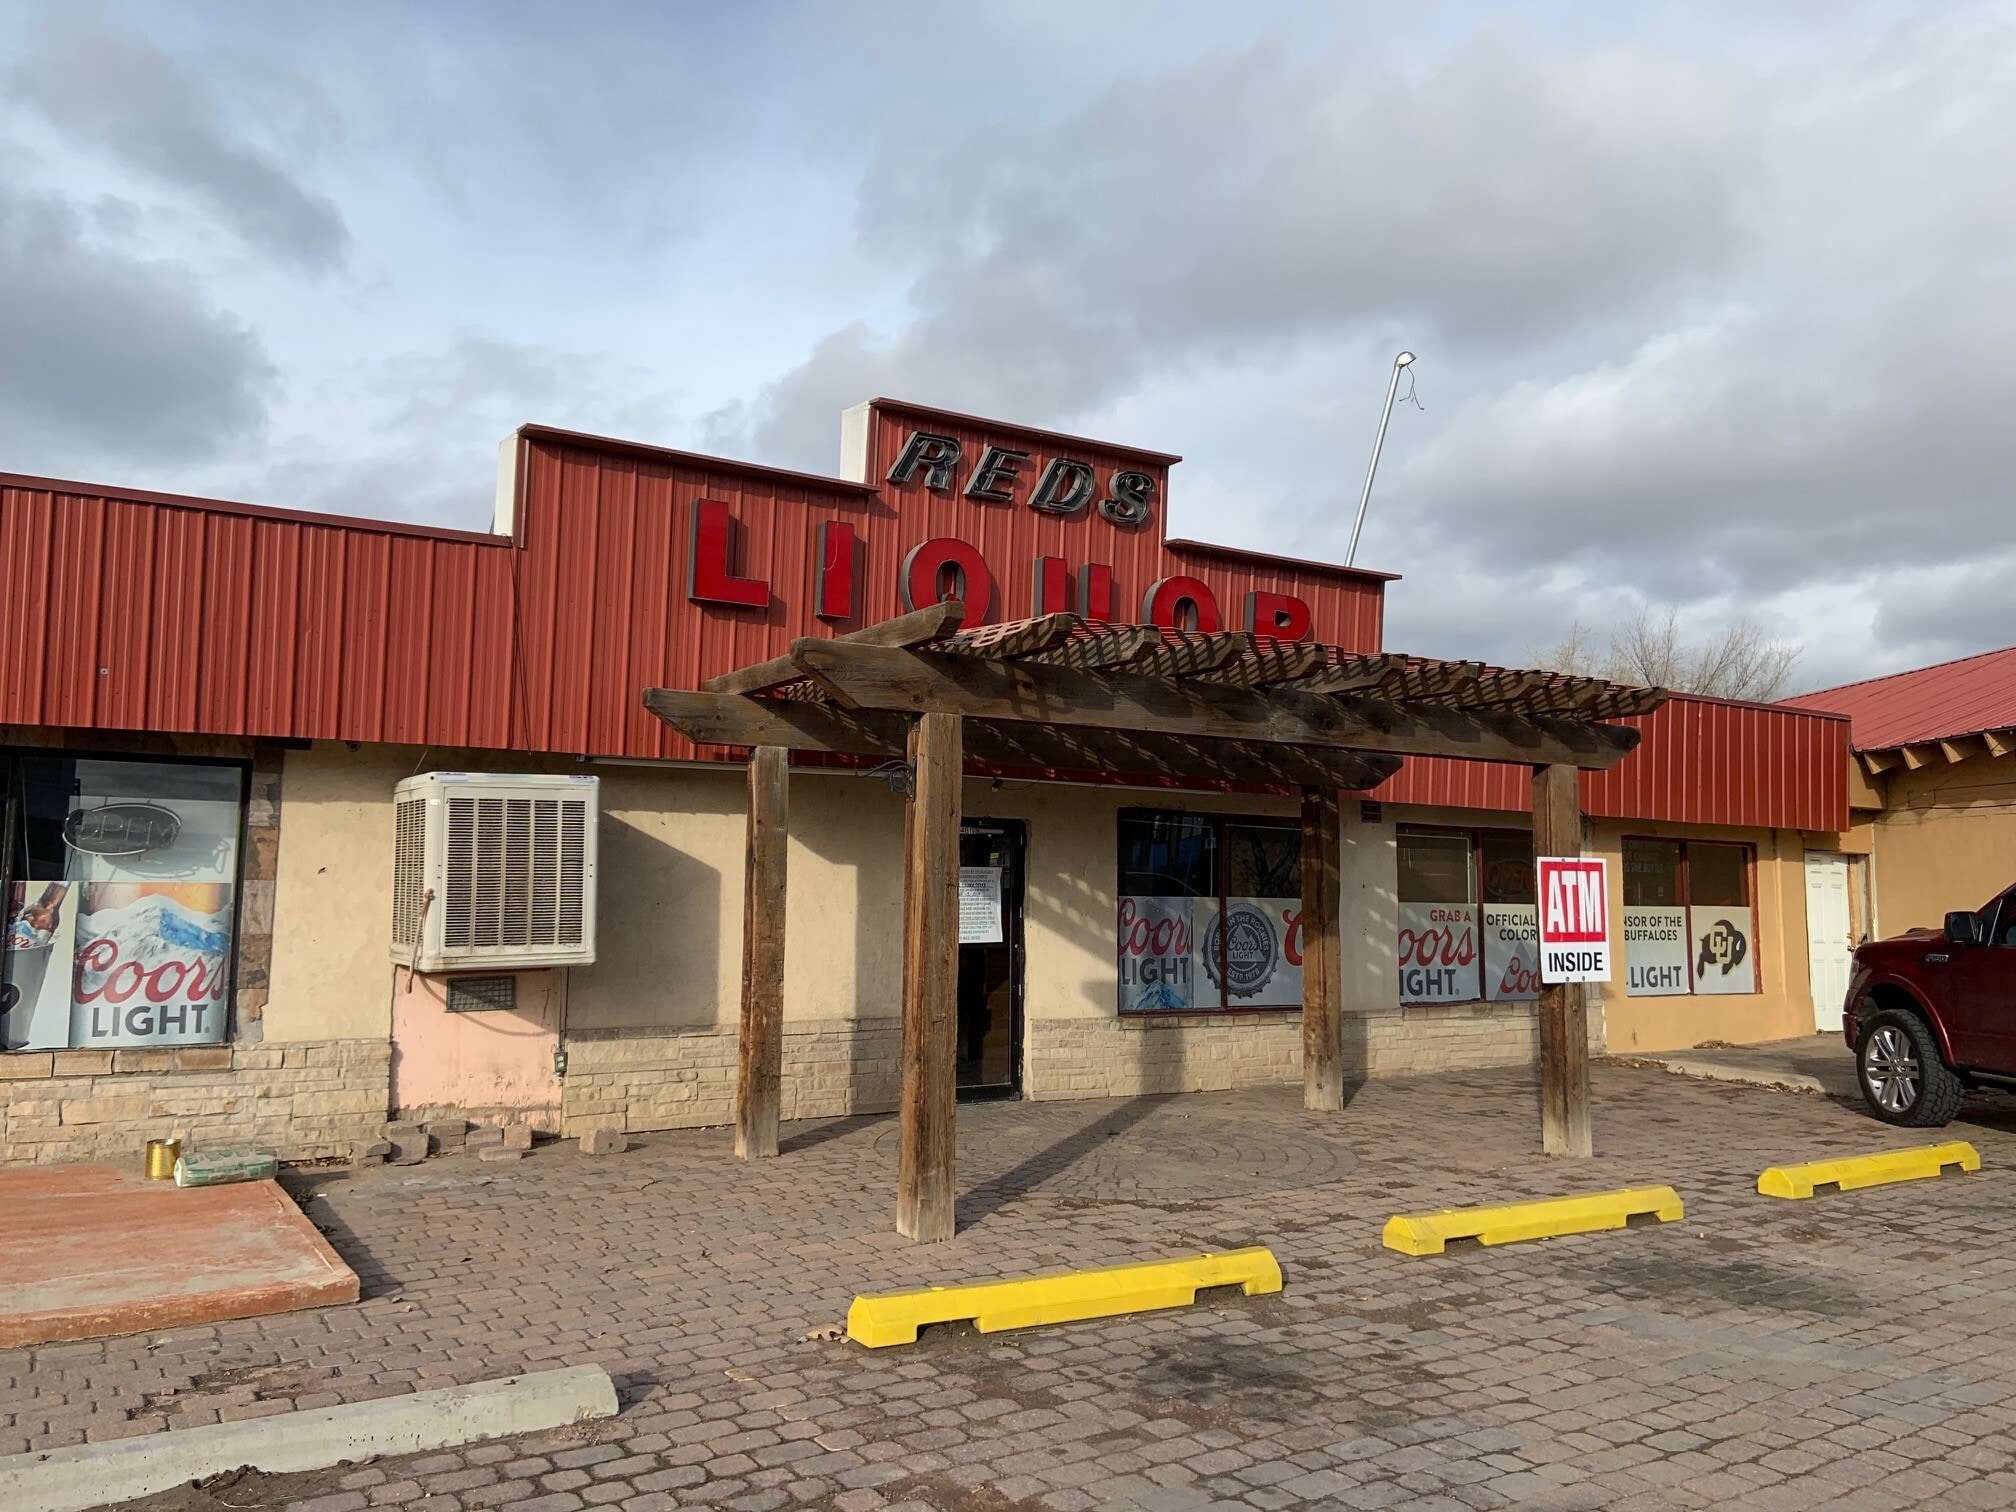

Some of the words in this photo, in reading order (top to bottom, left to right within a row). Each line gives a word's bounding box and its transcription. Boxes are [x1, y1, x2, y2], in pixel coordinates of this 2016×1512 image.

[885, 431, 1155, 524] REDS
[1547, 870, 1603, 933] ATM
[1429, 909, 1460, 922] GRAB
[1463, 910, 1472, 922] A
[1486, 913, 1536, 926] OFFICIAL
[1650, 916, 1662, 927] OF
[1664, 916, 1682, 927] THE
[1227, 917, 1236, 927] IN
[1251, 915, 1270, 951] ROCKIES
[1228, 936, 1260, 951] Coors
[1499, 929, 1537, 941] COLOR
[1624, 930, 1678, 941] BUFFALOES
[1232, 951, 1254, 960] LIGHT
[1398, 925, 1477, 967] oors
[74, 938, 225, 1004] Coors
[1122, 957, 1189, 985] LIGHT
[1548, 952, 1604, 972] INSIDE
[1399, 969, 1457, 996] IGHT
[1630, 965, 1682, 988] LIGHT
[92, 1004, 209, 1037] LIGHT
